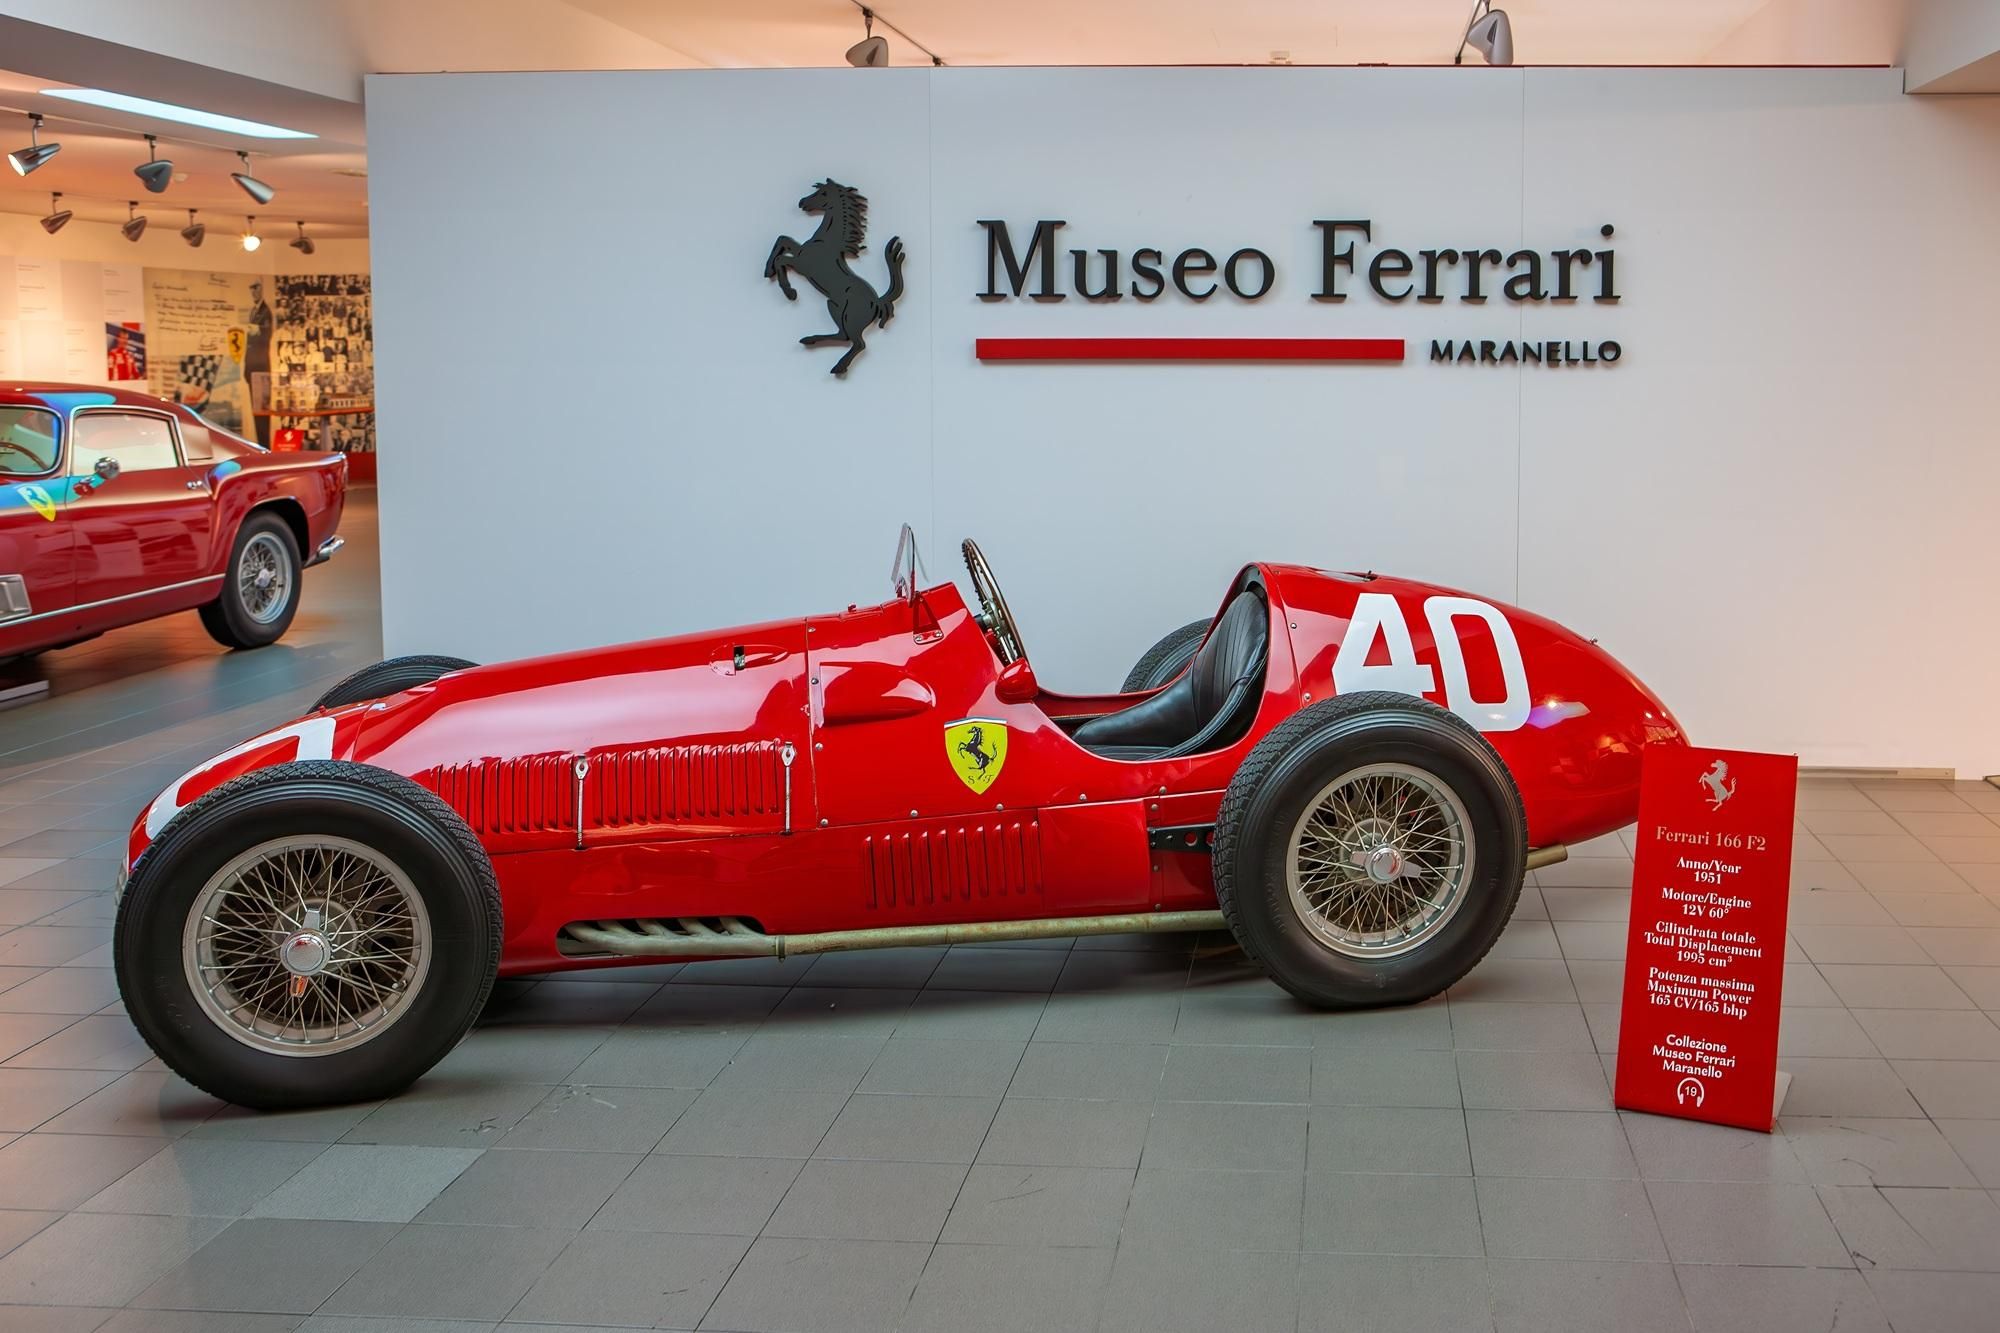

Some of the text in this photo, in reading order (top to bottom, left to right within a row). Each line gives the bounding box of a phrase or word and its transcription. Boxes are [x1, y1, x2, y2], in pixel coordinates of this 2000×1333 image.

[976, 219, 1621, 301] Museo Ferrari
[1430, 339, 1622, 364] MARANELLO
[1332, 593, 1531, 732] 40
[1656, 826, 1766, 851] Ferrari 166 F2
[1676, 856, 1742, 874] Anno/Year
[1694, 871, 1721, 885] 1951
[1661, 887, 1751, 909] Motore/Engine
[1682, 903, 1729, 919] 12V 60°
[1655, 920, 1756, 944] Cilindrata totale
[1644, 931, 1762, 958] Total Displacement
[1676, 950, 1705, 965] 1995
[1649, 966, 1755, 992] Potenza massima
[1647, 979, 1752, 1005] Maximum Power
[1649, 993, 1748, 1020] 165 CV/165 bhp
[1666, 1033, 1727, 1054] Collezione
[1652, 1045, 1736, 1068] Museo Ferrari
[1662, 1059, 1723, 1079] Maranello
[1684, 1085, 1698, 1097] 19
